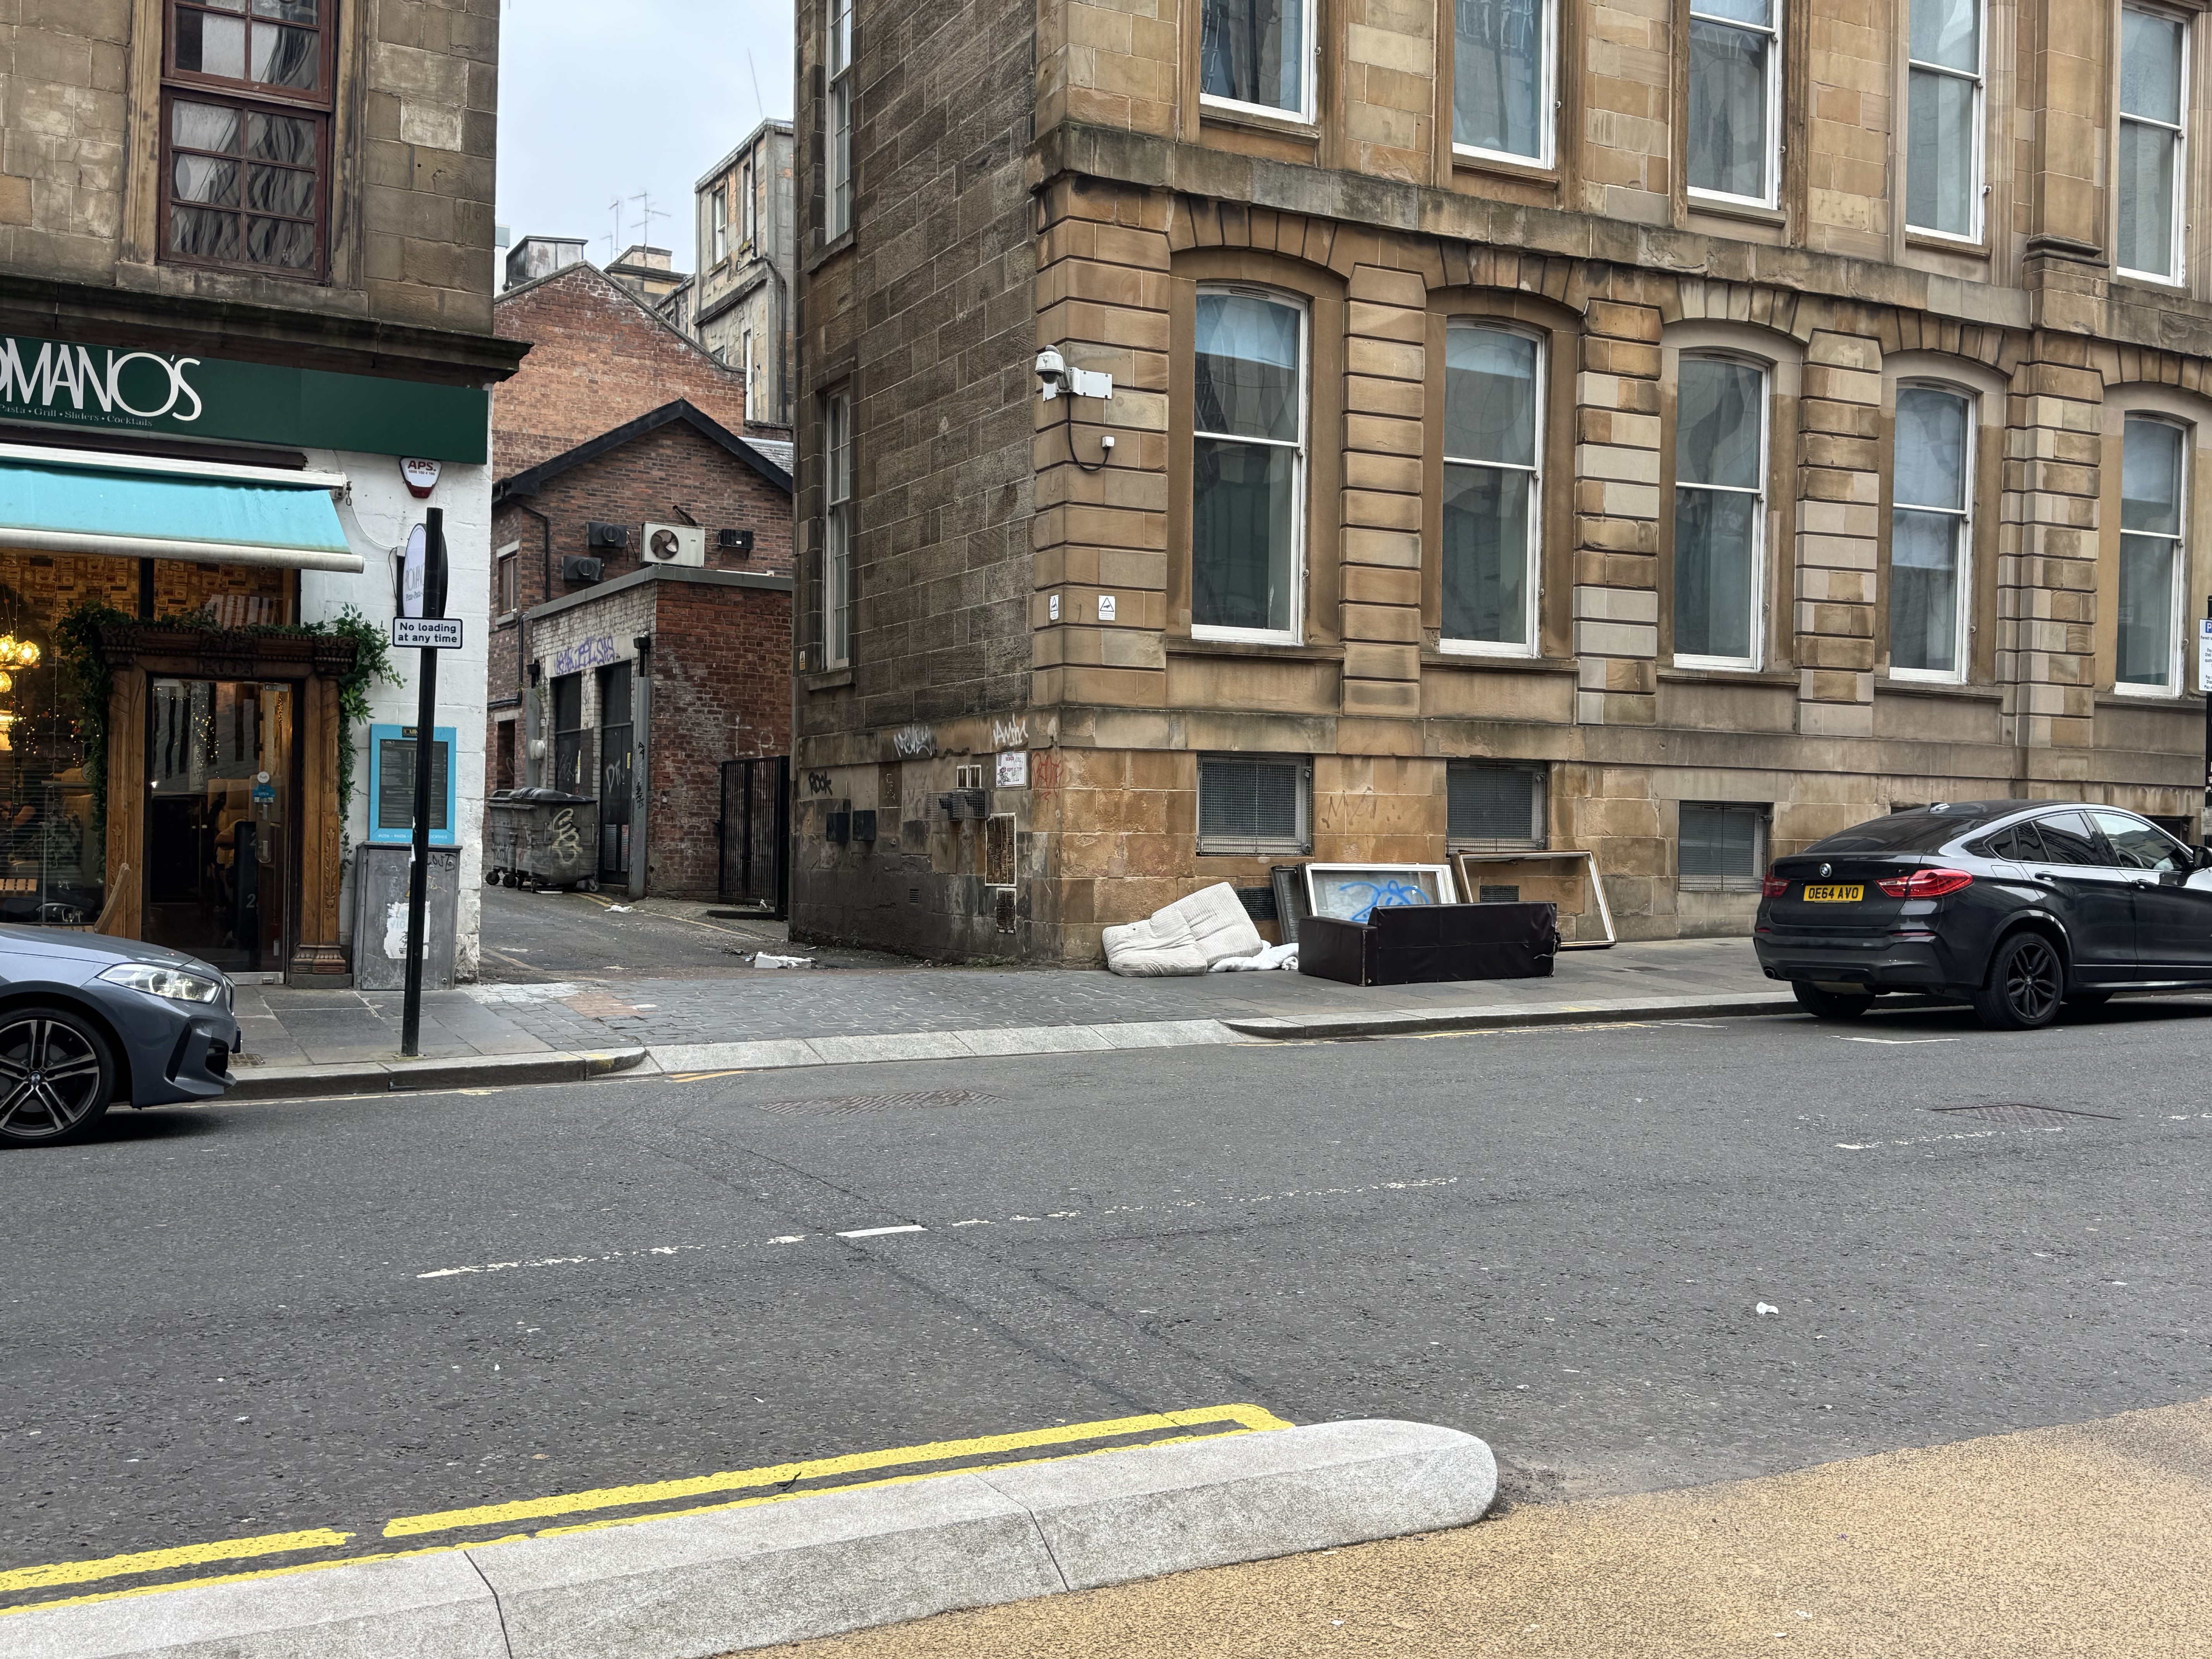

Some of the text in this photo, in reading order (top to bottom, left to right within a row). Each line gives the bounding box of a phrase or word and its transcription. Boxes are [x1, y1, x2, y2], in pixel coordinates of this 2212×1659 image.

[0, 338, 202, 421] MANO'S
[34, 408, 56, 417] Grill
[65, 411, 99, 422] Sliders
[107, 415, 152, 426] Cocktails
[400, 622, 456, 634] No loading
[2207, 623, 2212, 632] P
[412, 635, 430, 643] any
[434, 634, 457, 642] time
[1808, 887, 1858, 899] OE64 AVO
